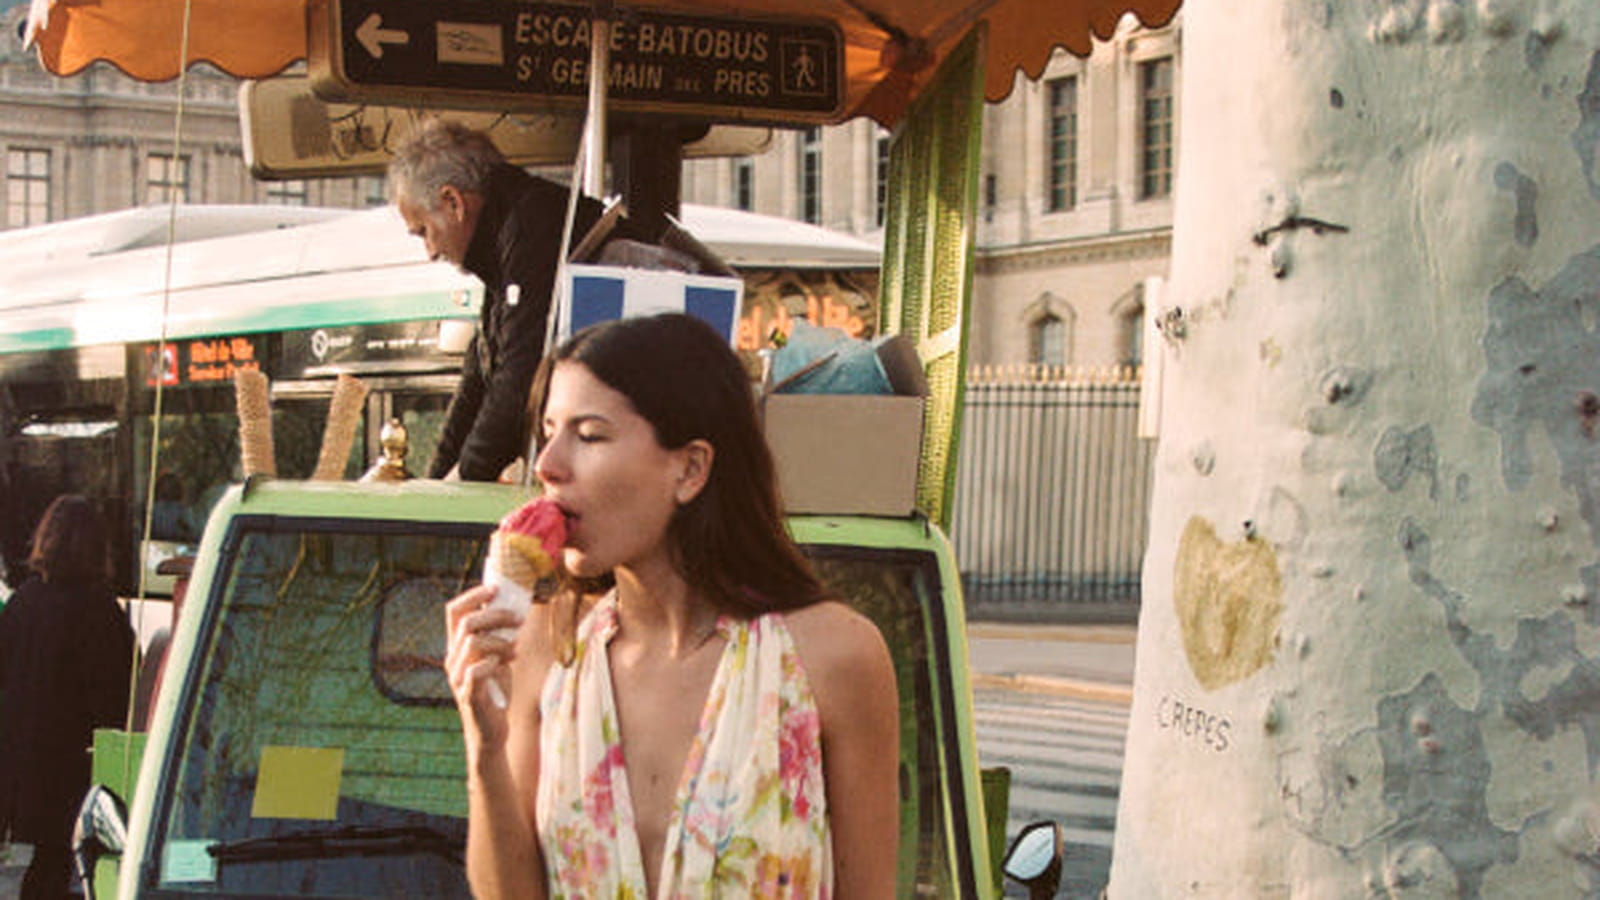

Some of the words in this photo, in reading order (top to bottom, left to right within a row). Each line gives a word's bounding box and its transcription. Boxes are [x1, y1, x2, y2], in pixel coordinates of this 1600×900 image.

[515, 12, 769, 61] ESCAE-BATOBUS
[551, 57, 663, 89] GEMAIN
[714, 68, 769, 97] PRES
[1157, 696, 1231, 752] CREPES
